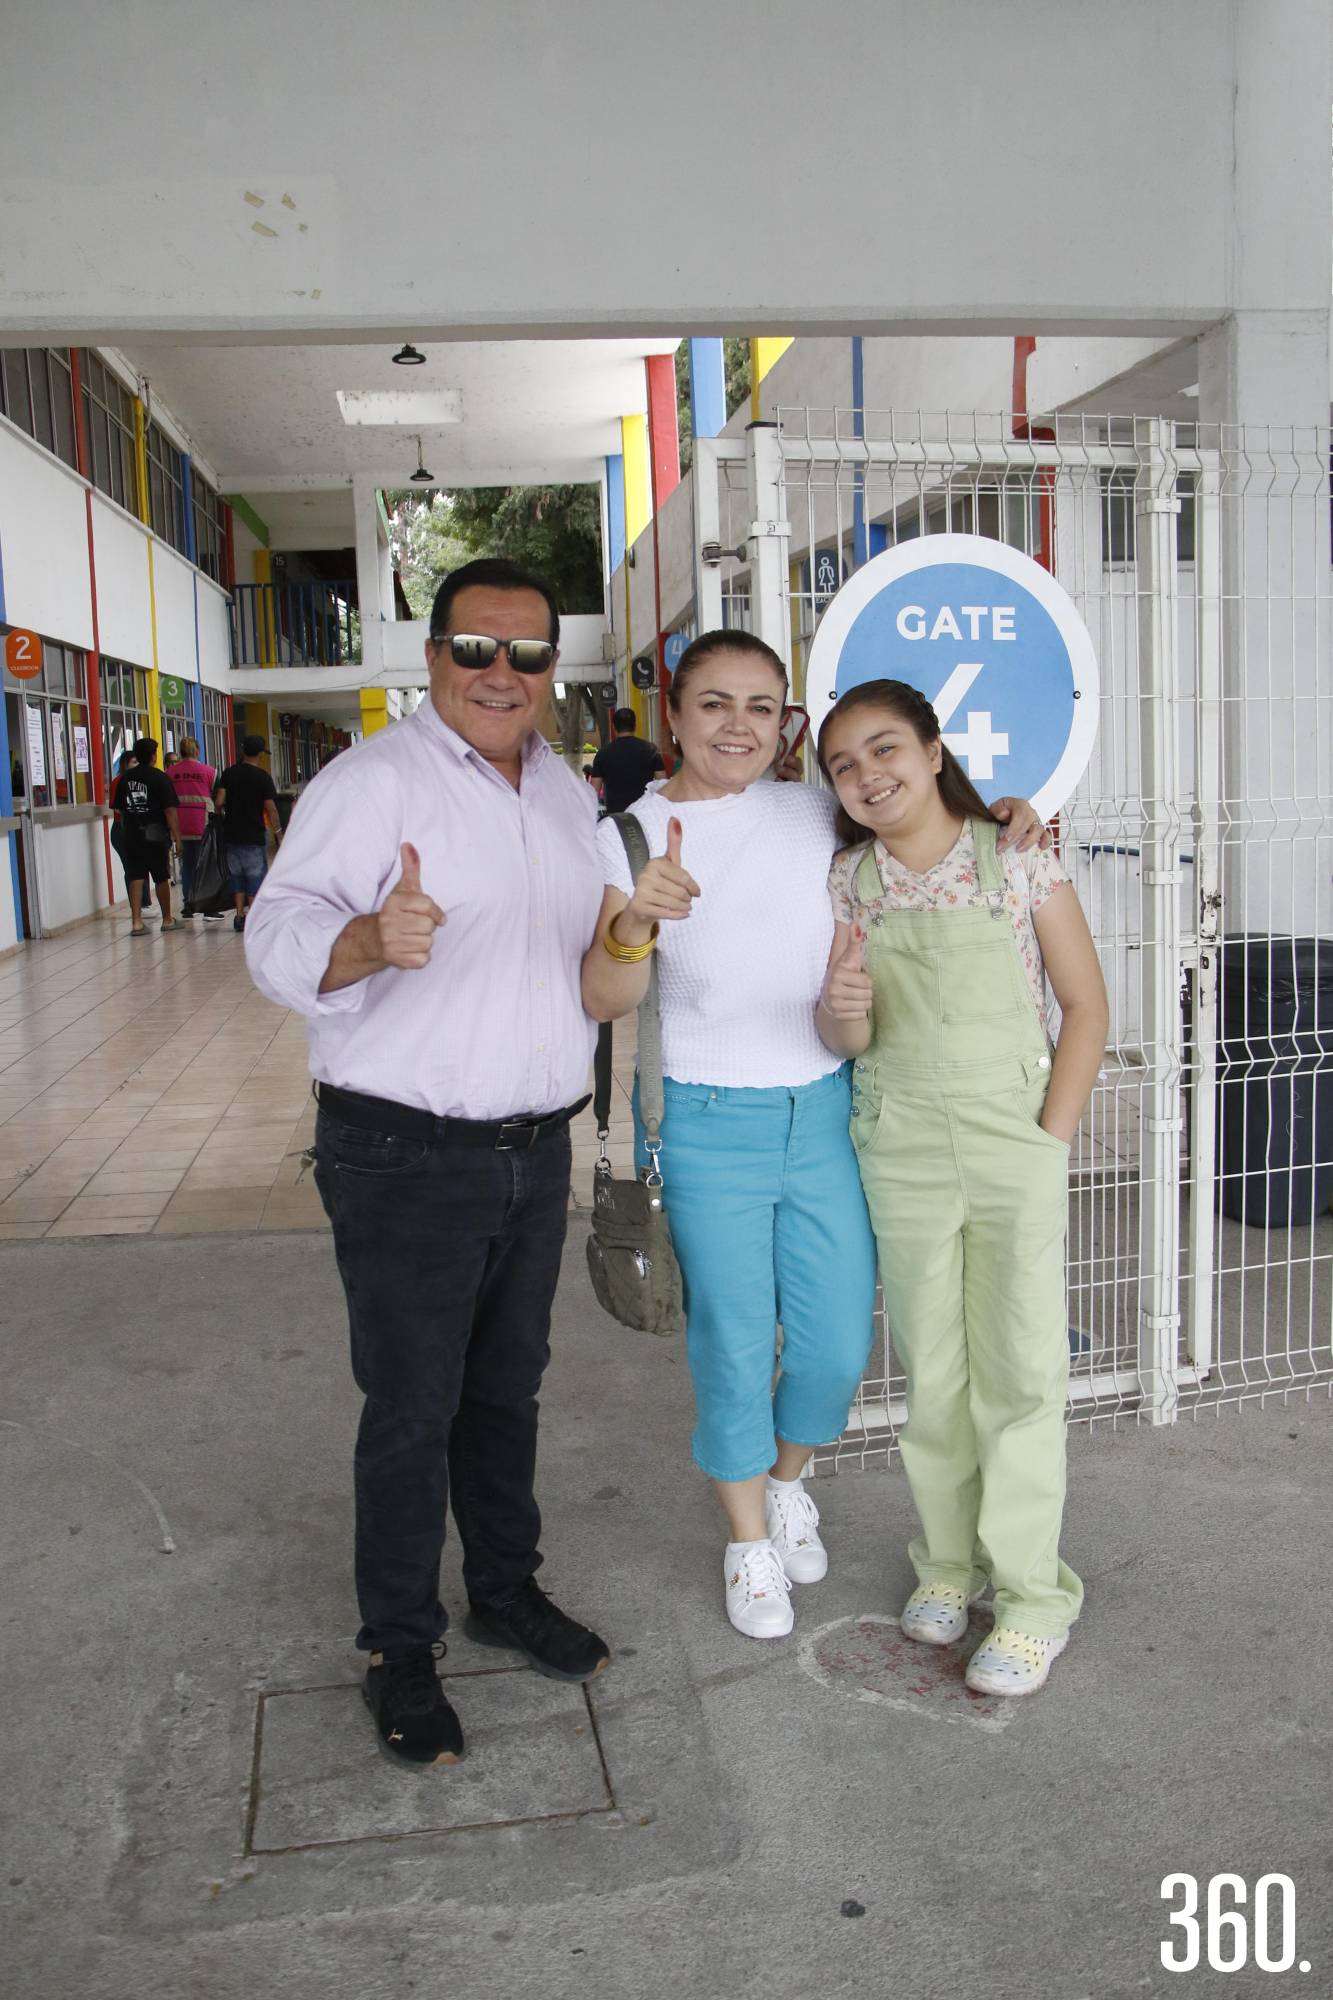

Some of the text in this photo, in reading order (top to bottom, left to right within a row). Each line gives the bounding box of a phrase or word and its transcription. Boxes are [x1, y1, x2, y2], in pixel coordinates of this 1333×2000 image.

[896, 605, 1017, 641] GATE
[15, 635, 32, 660] 2
[672, 639, 684, 658] 4
[167, 680, 178, 697] 3
[932, 663, 1009, 780] 4
